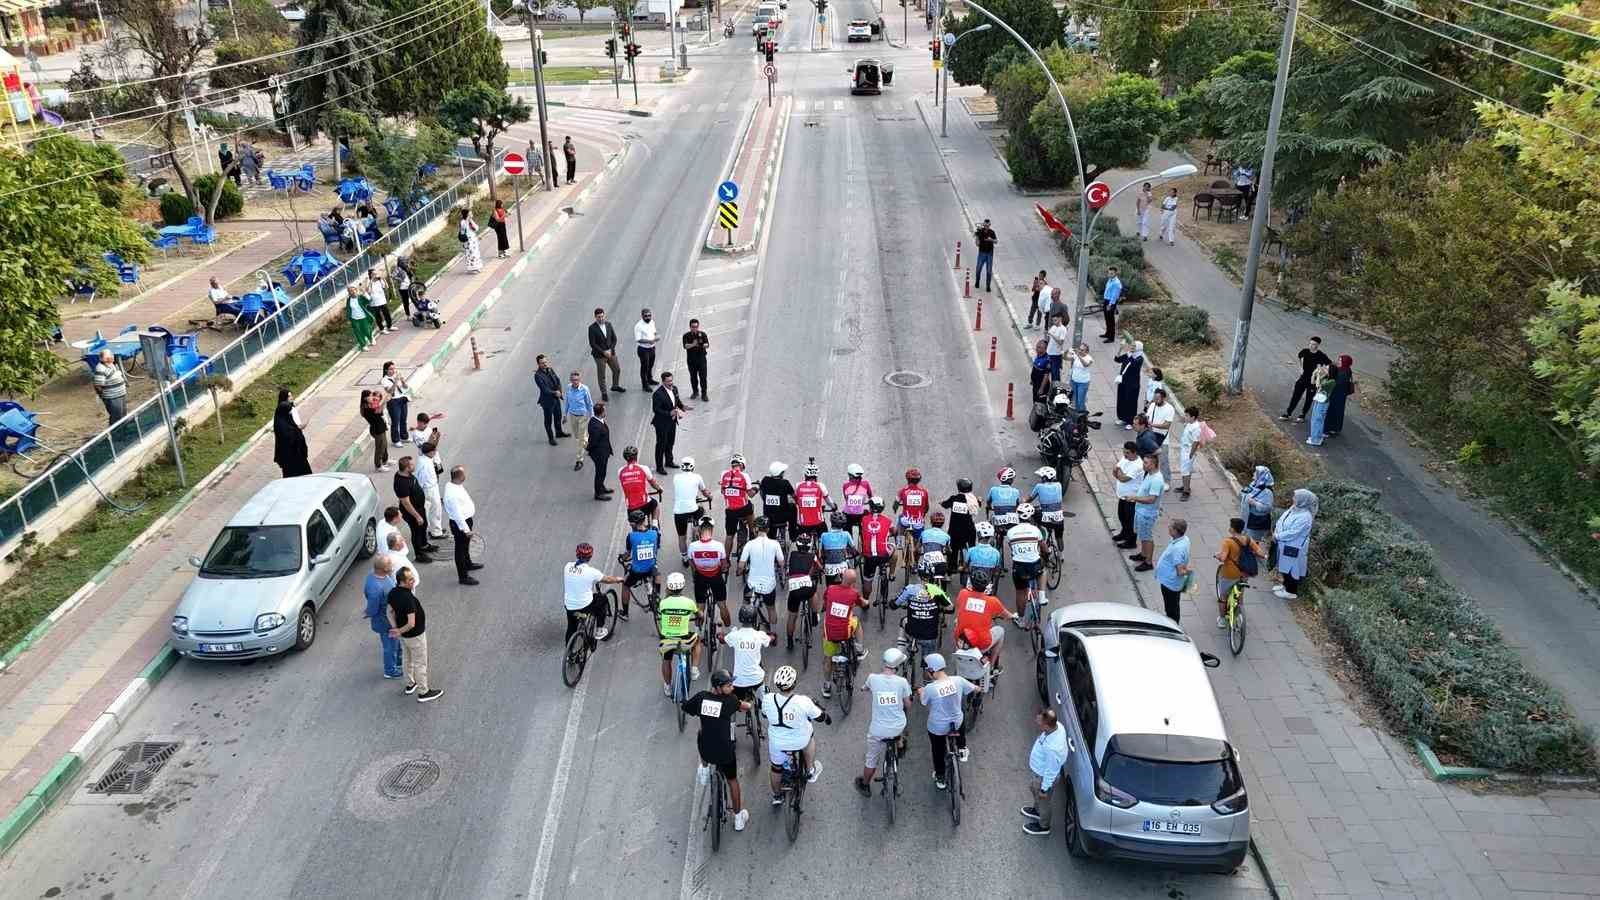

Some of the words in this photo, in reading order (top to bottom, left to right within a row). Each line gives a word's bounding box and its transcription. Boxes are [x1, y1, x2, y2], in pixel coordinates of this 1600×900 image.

[1152, 821, 1161, 830] 16
[1167, 822, 1178, 831] EH
[1183, 823, 1200, 833] 035
